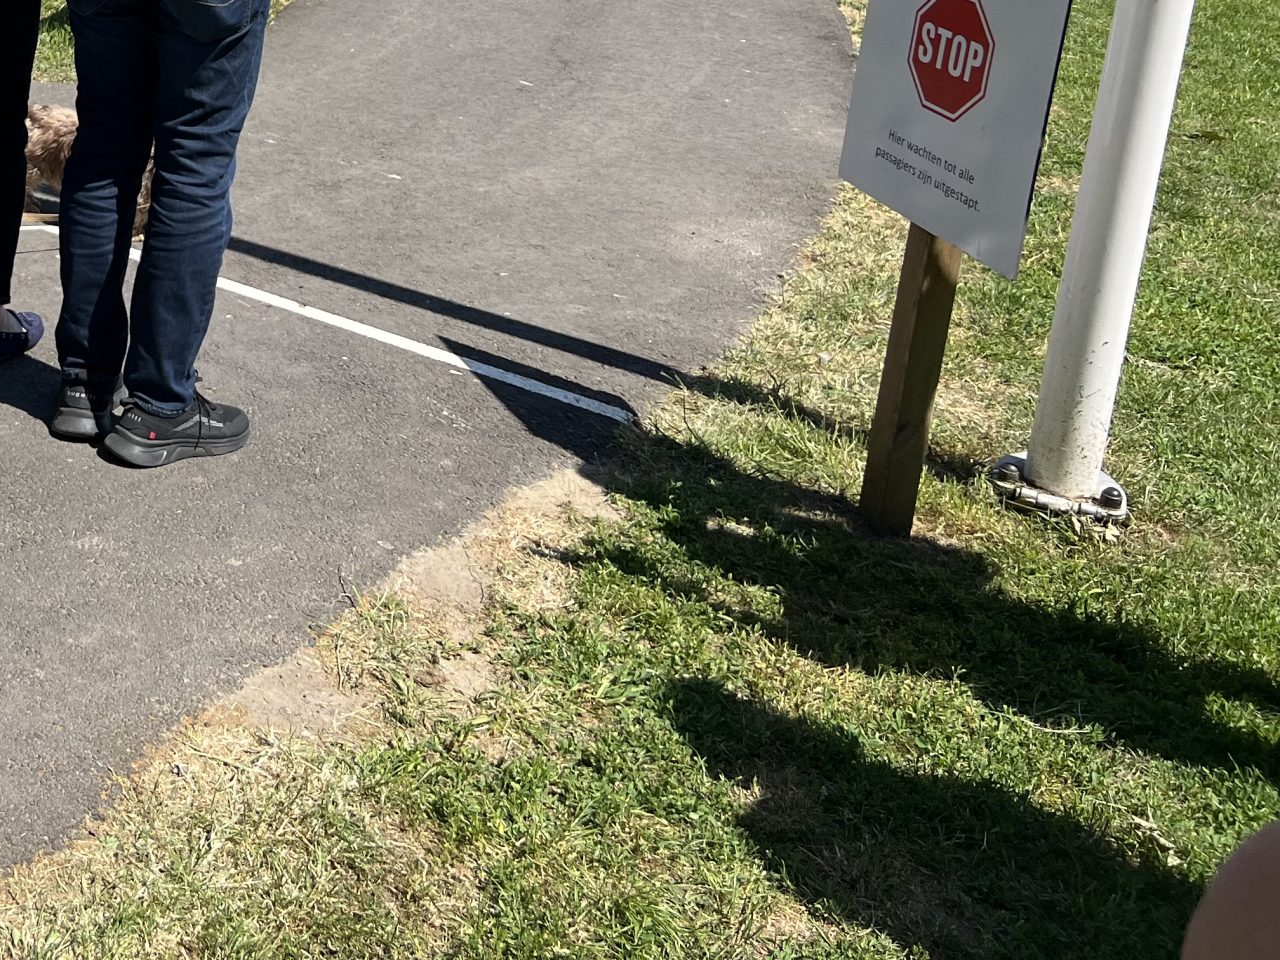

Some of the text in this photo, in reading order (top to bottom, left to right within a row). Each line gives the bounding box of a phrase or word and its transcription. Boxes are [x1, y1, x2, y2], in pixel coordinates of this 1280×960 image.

[917, 21, 984, 82] STOP
[875, 146, 981, 213] passagiers zijn uitgestapt.
[888, 128, 975, 184] Hier wachten tot alle
